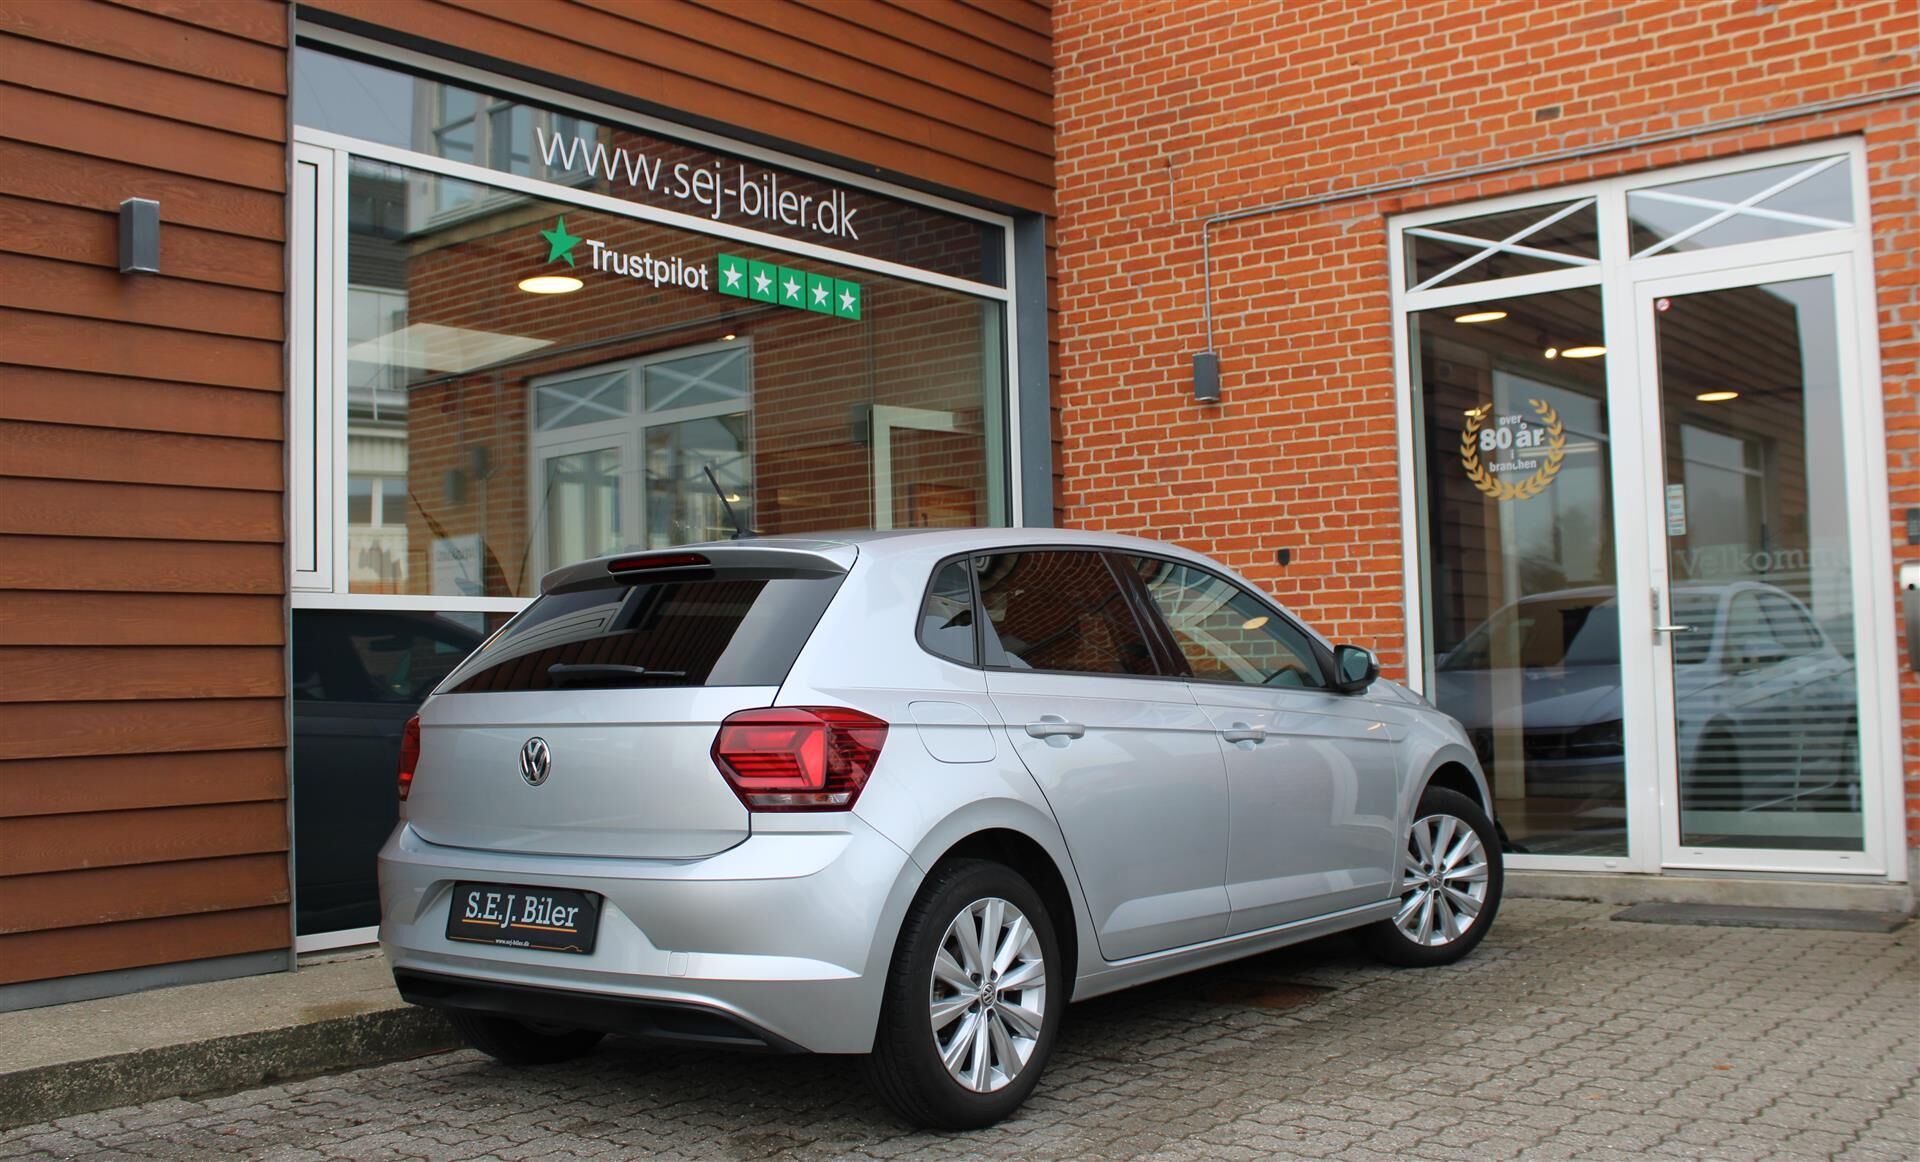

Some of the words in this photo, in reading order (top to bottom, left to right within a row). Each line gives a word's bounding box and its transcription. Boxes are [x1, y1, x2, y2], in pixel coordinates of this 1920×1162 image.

[536, 127, 859, 240] www.sej-biler.dk
[586, 239, 709, 291] Trustpilot
[1480, 427, 1512, 451] 80
[1516, 423, 1544, 447] år
[1500, 414, 1522, 425] over
[465, 891, 516, 928] S.E.J.
[521, 896, 579, 927] Biler
